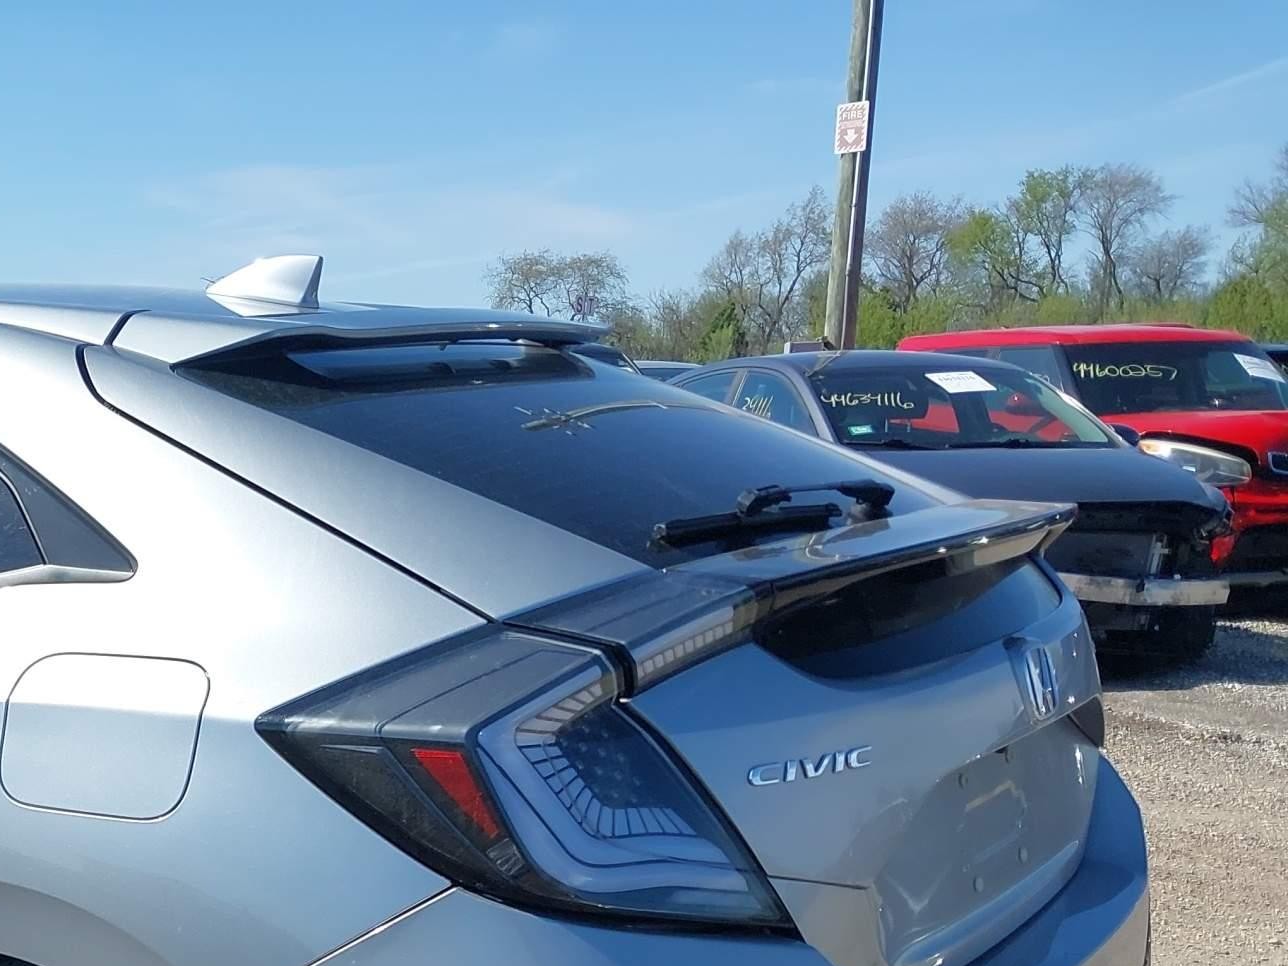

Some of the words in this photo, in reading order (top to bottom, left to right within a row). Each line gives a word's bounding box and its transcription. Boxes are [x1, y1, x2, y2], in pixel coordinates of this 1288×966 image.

[842, 110, 863, 120] FIRE
[820, 391, 915, 409] 44634116
[748, 744, 873, 786] CIVIC
